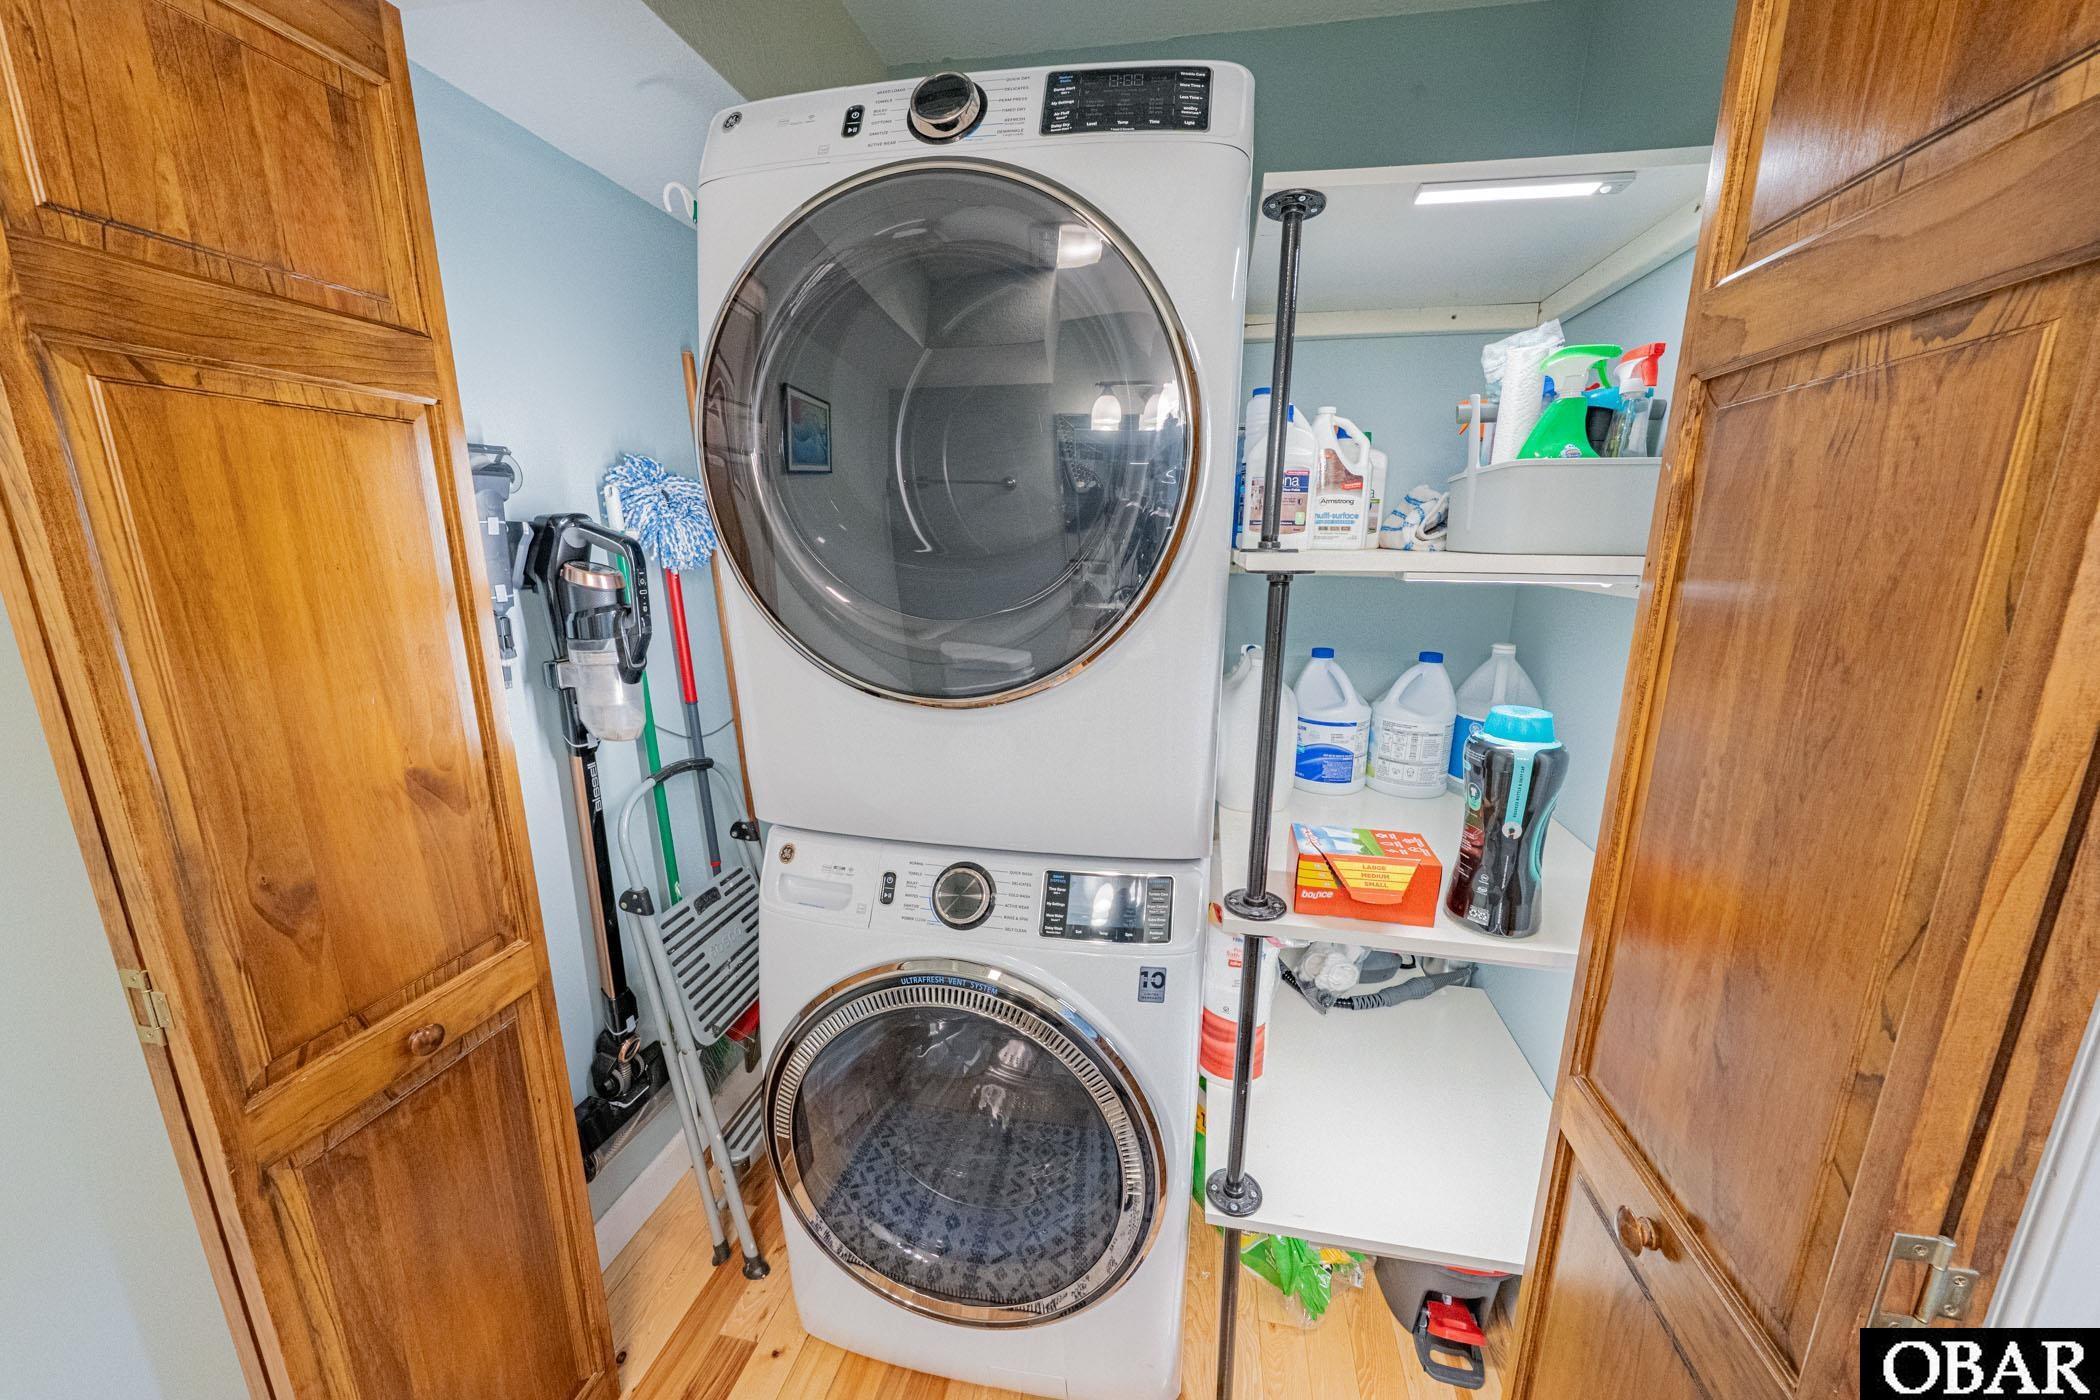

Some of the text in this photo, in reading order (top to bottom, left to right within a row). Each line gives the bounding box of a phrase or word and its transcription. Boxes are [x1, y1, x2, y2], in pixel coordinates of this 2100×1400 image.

[1320, 497, 1355, 506] Armstrong
[1360, 872, 1390, 880] MEDIUM
[1301, 889, 1334, 899] bounce
[900, 976, 998, 994] ULTRAFRESH VENT SYSTEM
